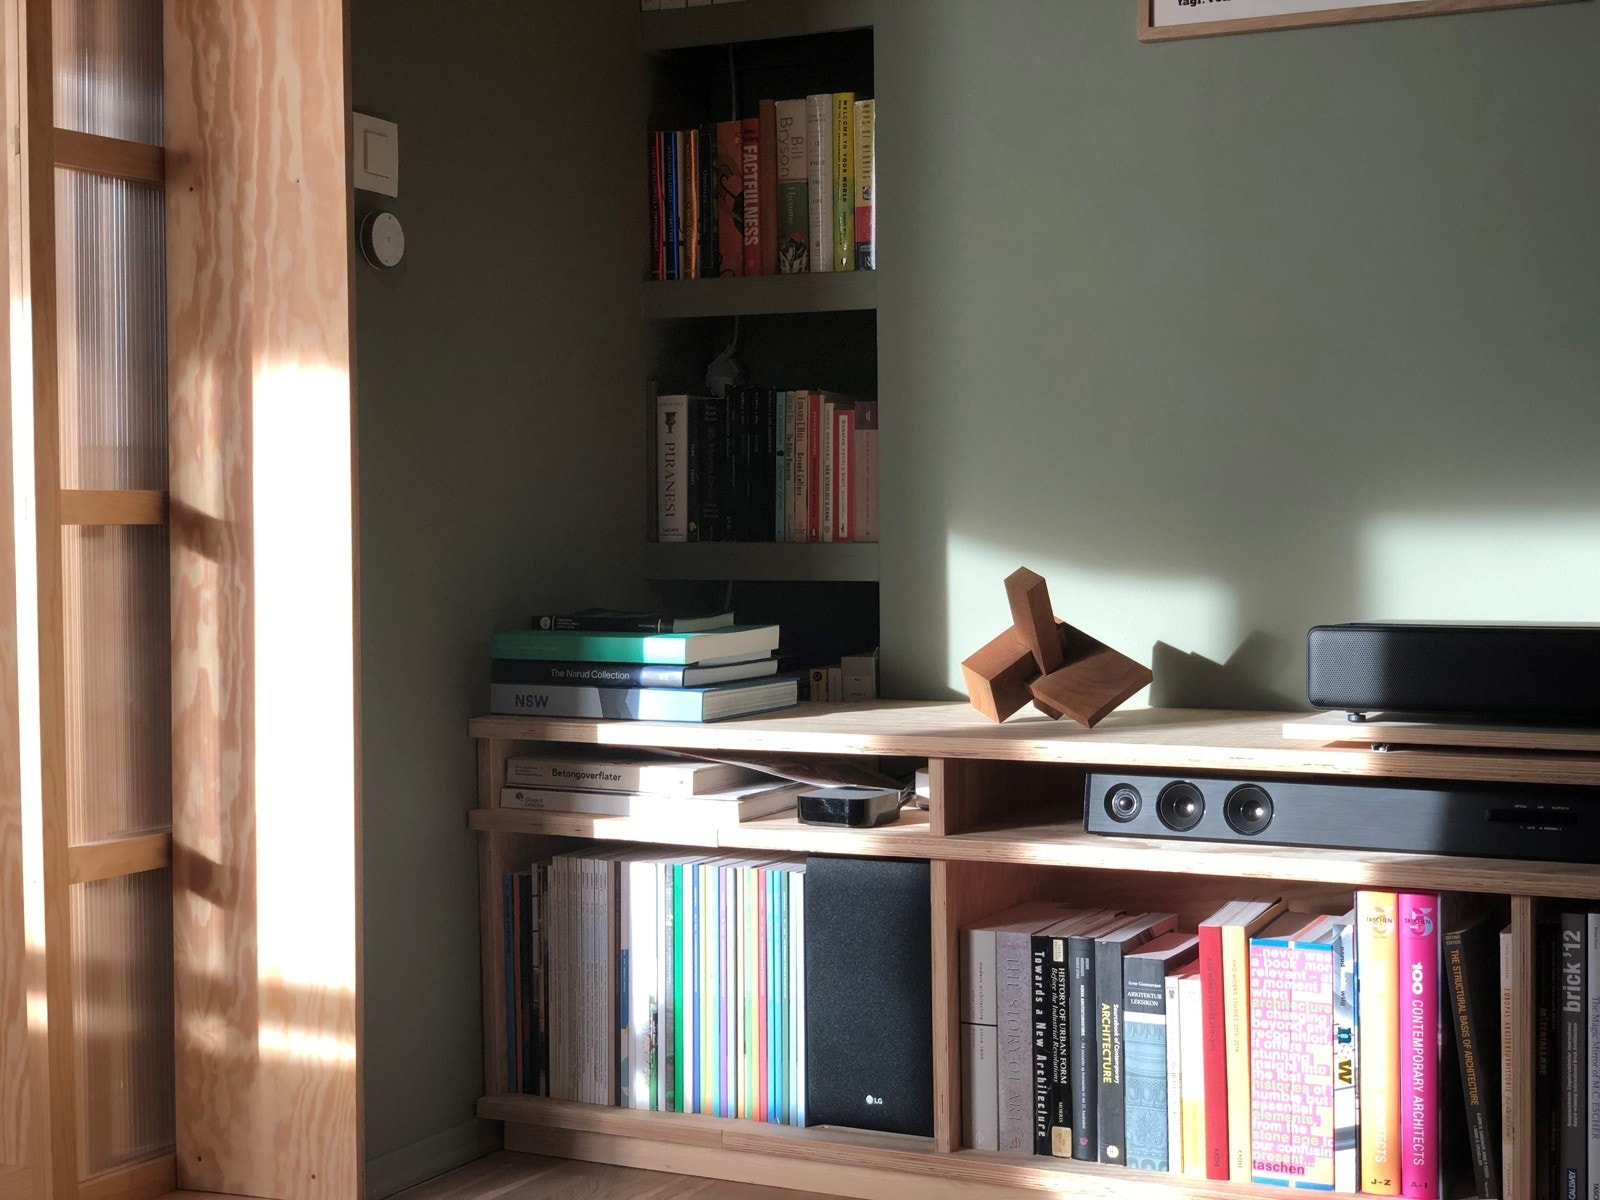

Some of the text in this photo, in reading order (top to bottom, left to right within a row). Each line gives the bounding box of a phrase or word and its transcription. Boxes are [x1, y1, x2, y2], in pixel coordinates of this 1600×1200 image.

[778, 117, 794, 178] Bryson
[791, 136, 804, 159] Bill
[842, 141, 848, 150] TO
[743, 144, 759, 247] FACTFULNESS
[786, 186, 796, 225] Hjemme
[664, 442, 676, 518] PIRANESI
[551, 668, 630, 681] The Narud Collection
[515, 694, 549, 709] NSW
[552, 768, 622, 782] Betongoverflater
[1366, 916, 1393, 924] TASCHEN
[1404, 917, 1431, 926] TASCHEN
[1264, 957, 1297, 970] book
[1305, 962, 1333, 974] mor
[1034, 951, 1046, 1003] Towards
[1051, 968, 1059, 990] Before
[1264, 979, 1318, 993] moment
[1127, 991, 1162, 1000] ARKITEKTUR
[1252, 988, 1289, 1000] when
[1562, 962, 1581, 1013] brick
[1130, 998, 1158, 1007] LEKSIKON
[1252, 998, 1333, 1015] architecture
[1592, 996, 1600, 1012] The
[1052, 1005, 1060, 1040] Industrial
[1058, 968, 1069, 1084] HISTORY OF URBAN FORM
[1252, 1018, 1303, 1033] beyond
[1266, 1009, 1328, 1027] changing
[1590, 1014, 1600, 1037] Magic
[1036, 1022, 1047, 1048] New
[1337, 1027, 1352, 1044] n
[1451, 949, 1479, 1106] THE STRUCTURAL BASIS OF ARCHITECTURE
[1006, 959, 1021, 1122] THE STORY OF ART
[1101, 1003, 1112, 1084] ARCHITECTURE
[1052, 1041, 1061, 1084] Revolutions
[1253, 1049, 1311, 1067] stunning
[1504, 1021, 1512, 1092] ARKITEKTURHISTORIE
[1591, 1041, 1600, 1066] Mirror
[1113, 1045, 1121, 1084] Contemporary
[1252, 1058, 1328, 1076] insight into
[1411, 962, 1425, 1166] 100 CONTEMPORARY ARCHITECTS
[1591, 1069, 1600, 1080] of
[1037, 1054, 1048, 1137] Architecture
[1252, 1079, 1328, 1096] histories of
[874, 1097, 883, 1105] LG
[1252, 1089, 1330, 1106] humble but
[1252, 1100, 1315, 1115] essential
[1252, 1120, 1309, 1136] from the
[1591, 1102, 1600, 1140] ESCHER
[1252, 1131, 1290, 1144] stone
[1293, 1135, 1319, 1149] age
[1253, 1142, 1334, 1158] our confusin
[1252, 1159, 1306, 1176] taschen
